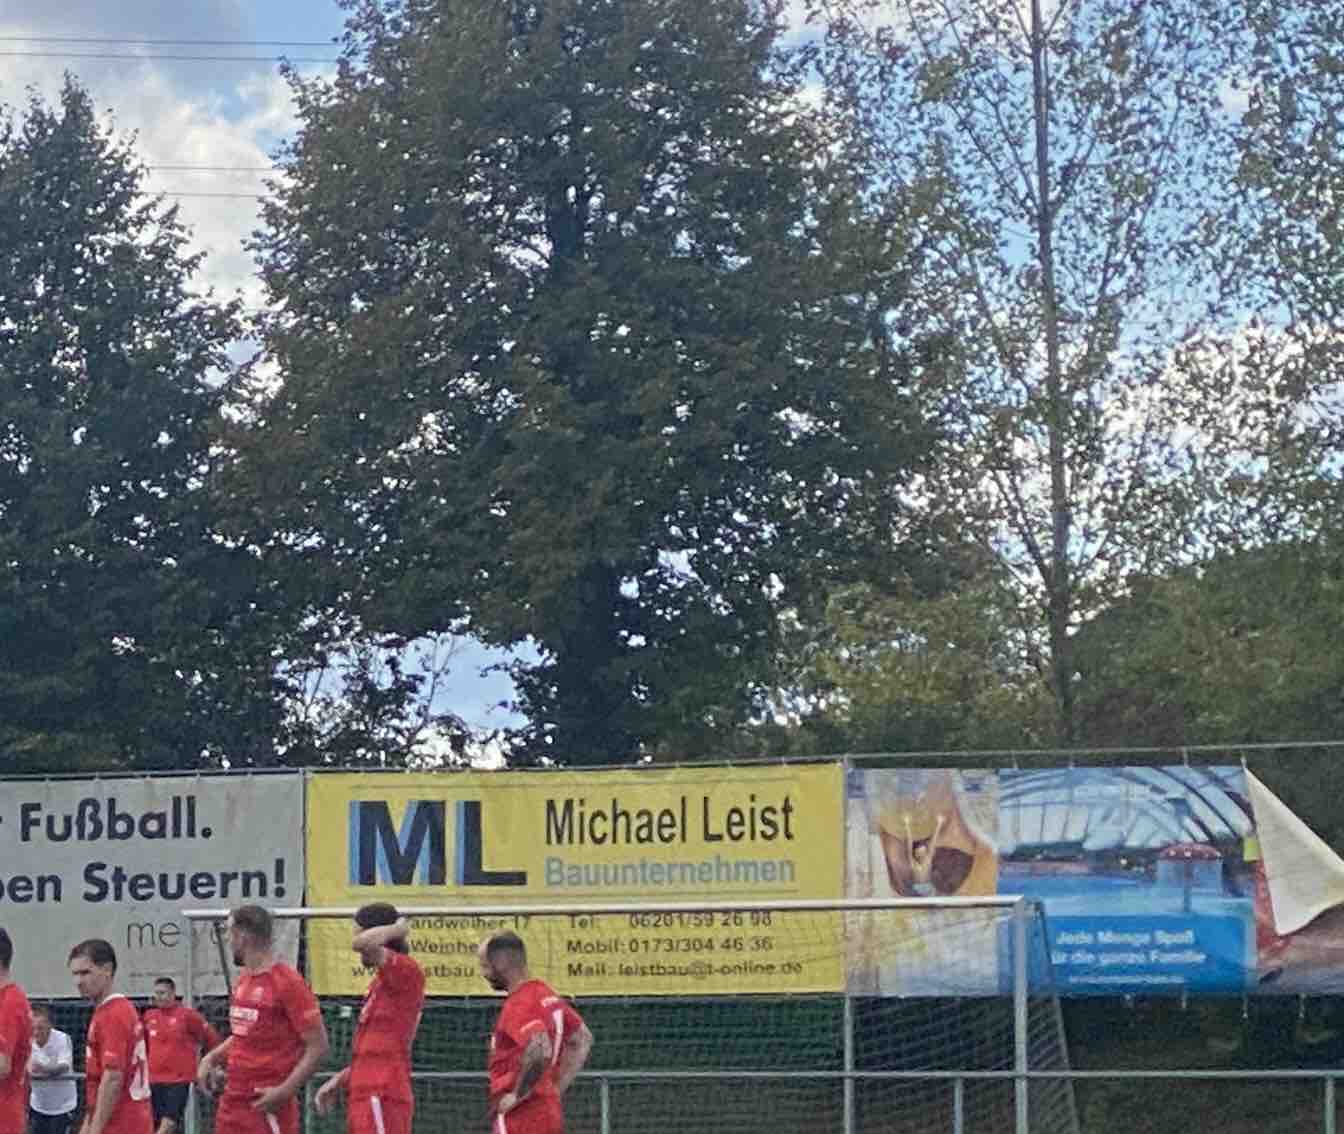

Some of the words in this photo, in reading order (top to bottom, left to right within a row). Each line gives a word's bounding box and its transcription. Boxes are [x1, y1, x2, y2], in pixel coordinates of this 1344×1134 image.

[20, 795, 213, 842] Fußball.
[545, 795, 688, 845] Michael
[702, 795, 794, 842] Leist
[349, 800, 528, 886] ML
[82, 857, 288, 903] Steuern!
[544, 855, 795, 889] Bauunternehmen
[566, 939, 625, 954] Mobil:
[628, 938, 714, 954] 0173/304
